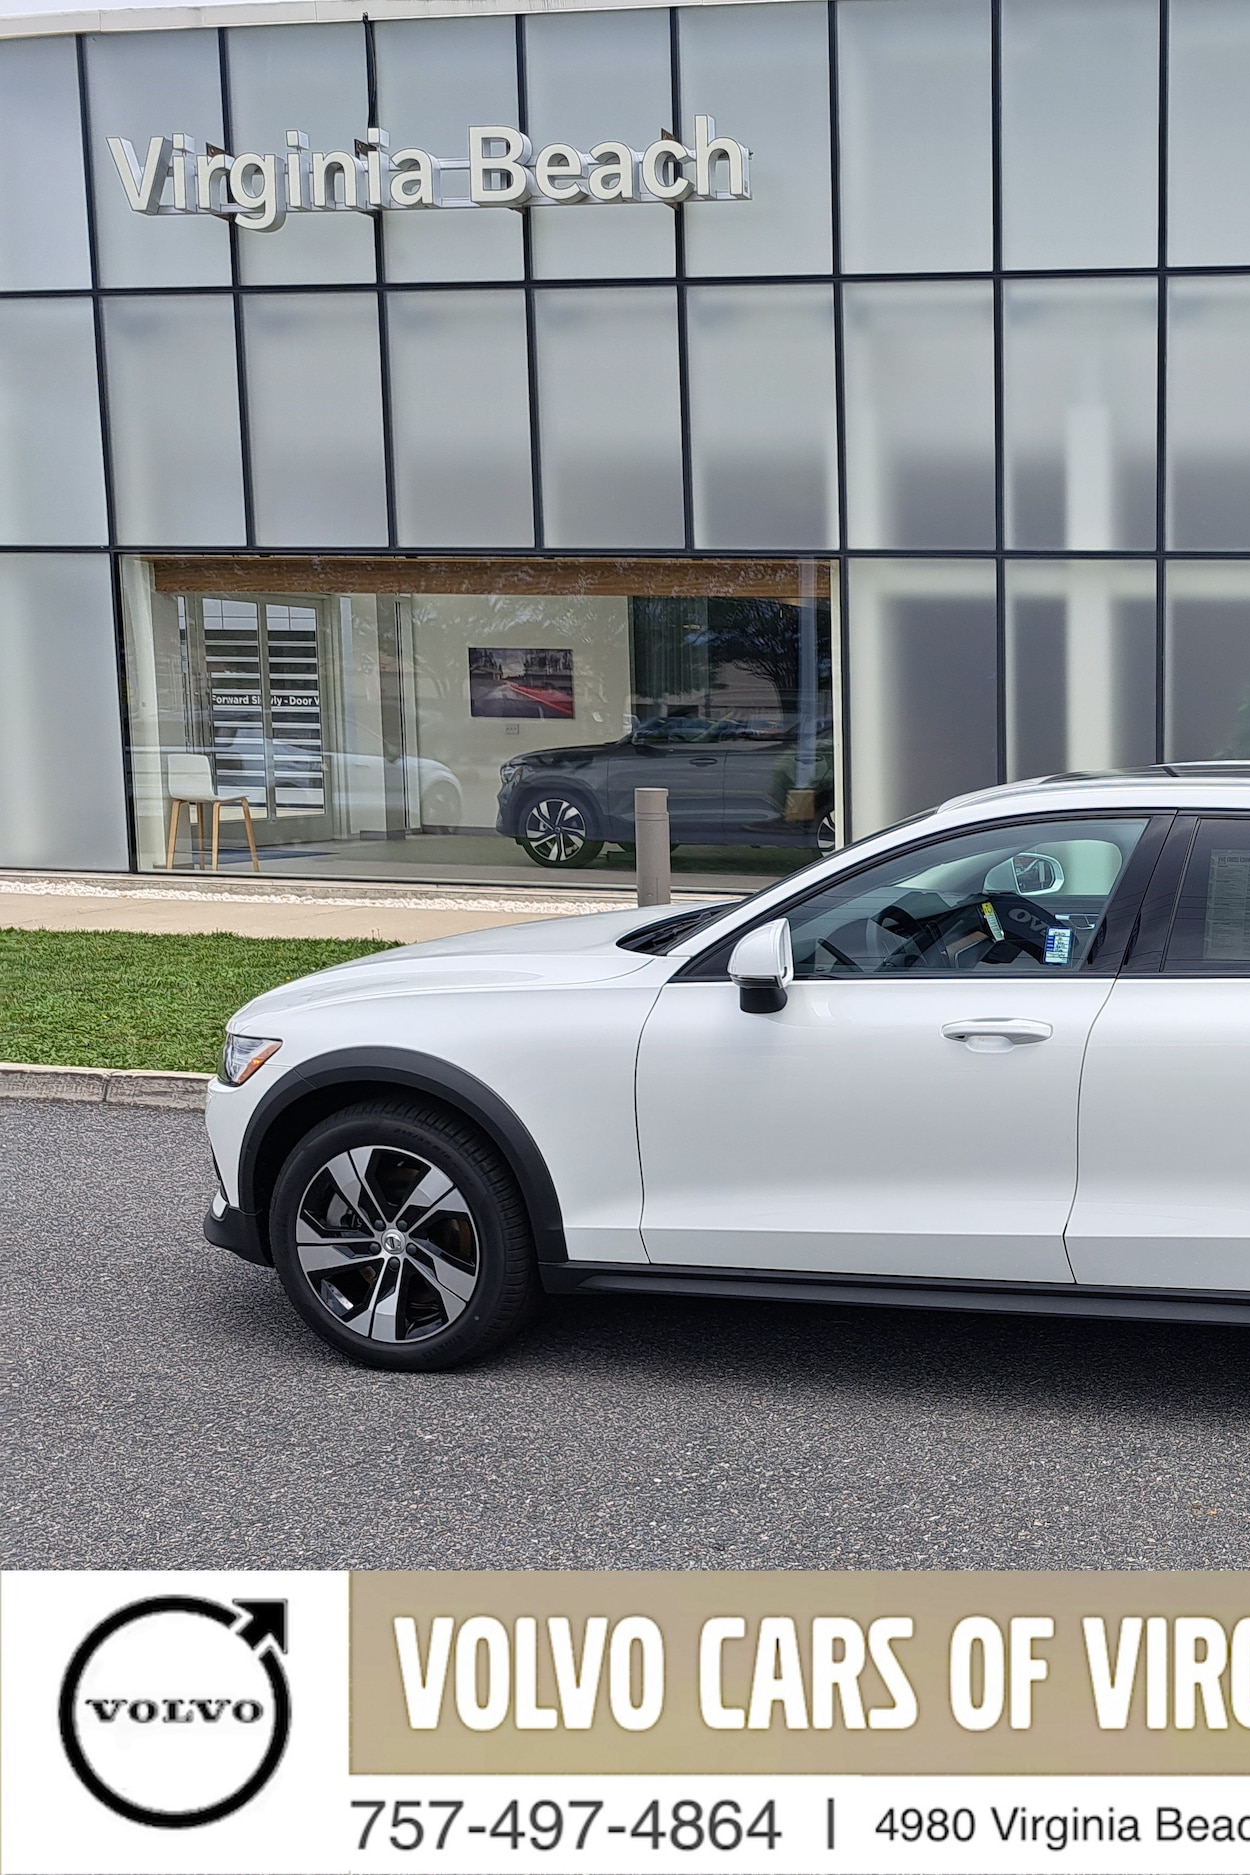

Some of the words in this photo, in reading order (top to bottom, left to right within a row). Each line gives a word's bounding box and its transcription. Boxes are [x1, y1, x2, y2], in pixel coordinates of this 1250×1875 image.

[105, 127, 442, 233] Virginia
[468, 114, 750, 207] Beach
[289, 696, 313, 706] Door
